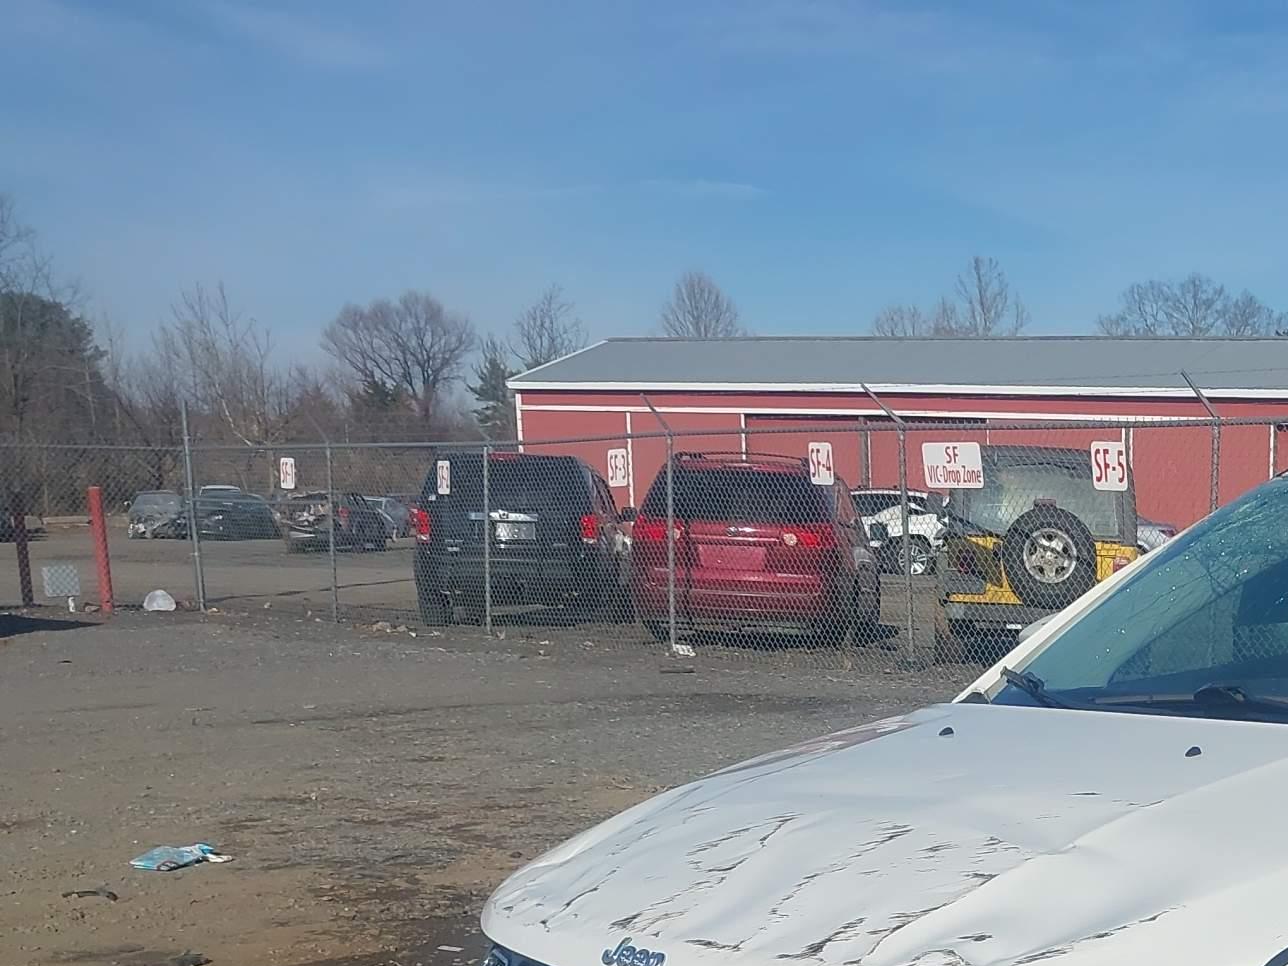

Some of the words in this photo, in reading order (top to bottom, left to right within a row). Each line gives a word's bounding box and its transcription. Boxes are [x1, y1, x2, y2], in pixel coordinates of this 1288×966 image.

[609, 454, 627, 481] SF-3
[810, 447, 832, 478] SF-4
[944, 446, 959, 464] SF
[1094, 448, 1125, 483] SF-5
[927, 464, 961, 486] VIC-Drop
[961, 465, 982, 483] Zone
